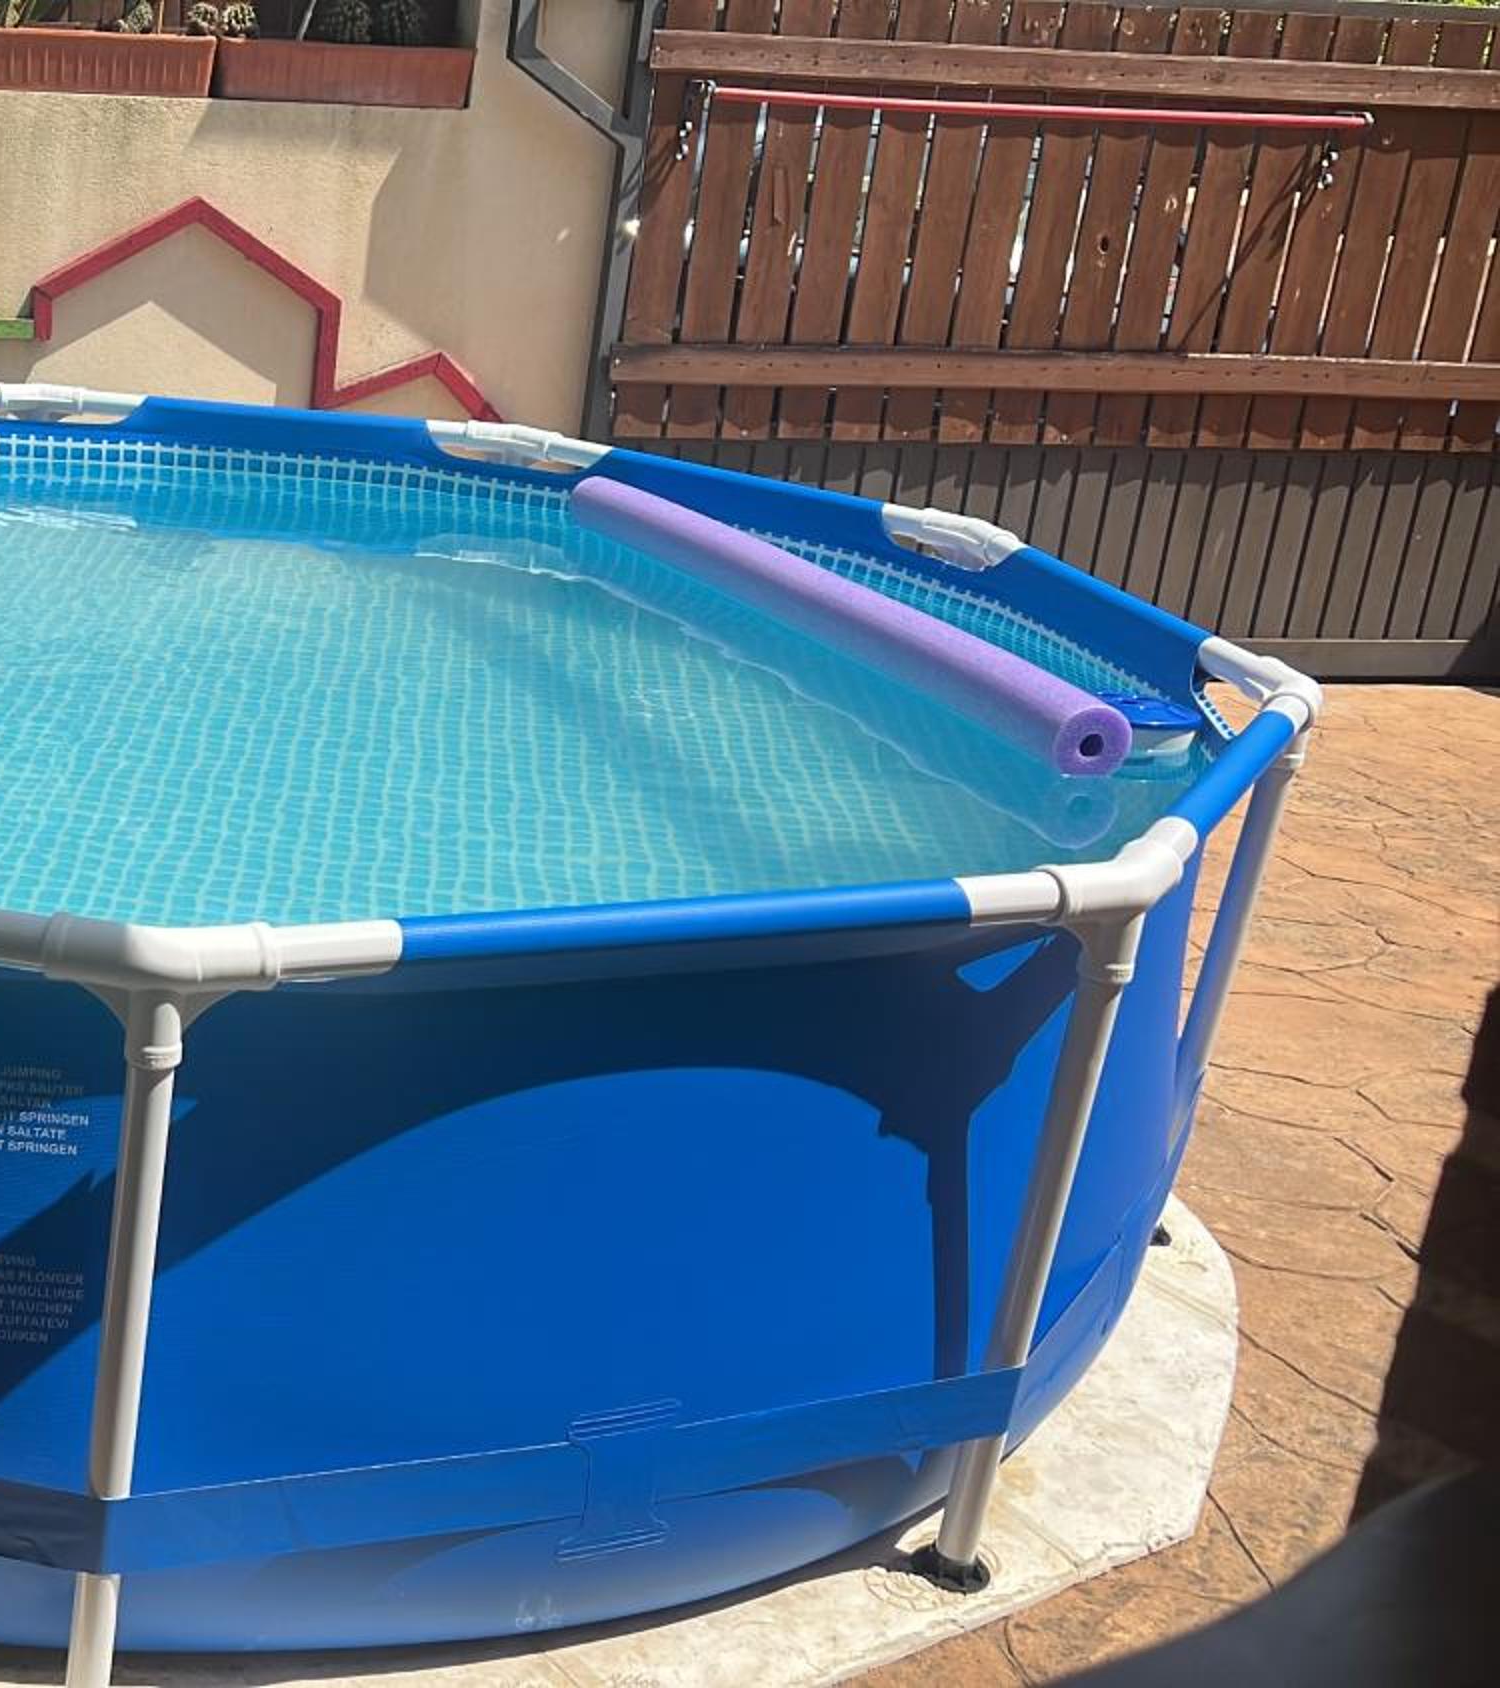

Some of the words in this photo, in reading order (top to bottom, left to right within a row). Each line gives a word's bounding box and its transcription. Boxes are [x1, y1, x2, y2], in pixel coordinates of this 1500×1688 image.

[19, 1111, 89, 1126] SPRINGEN
[7, 1125, 67, 1140] SALTATE
[7, 1141, 77, 1156] SPRINGEN
